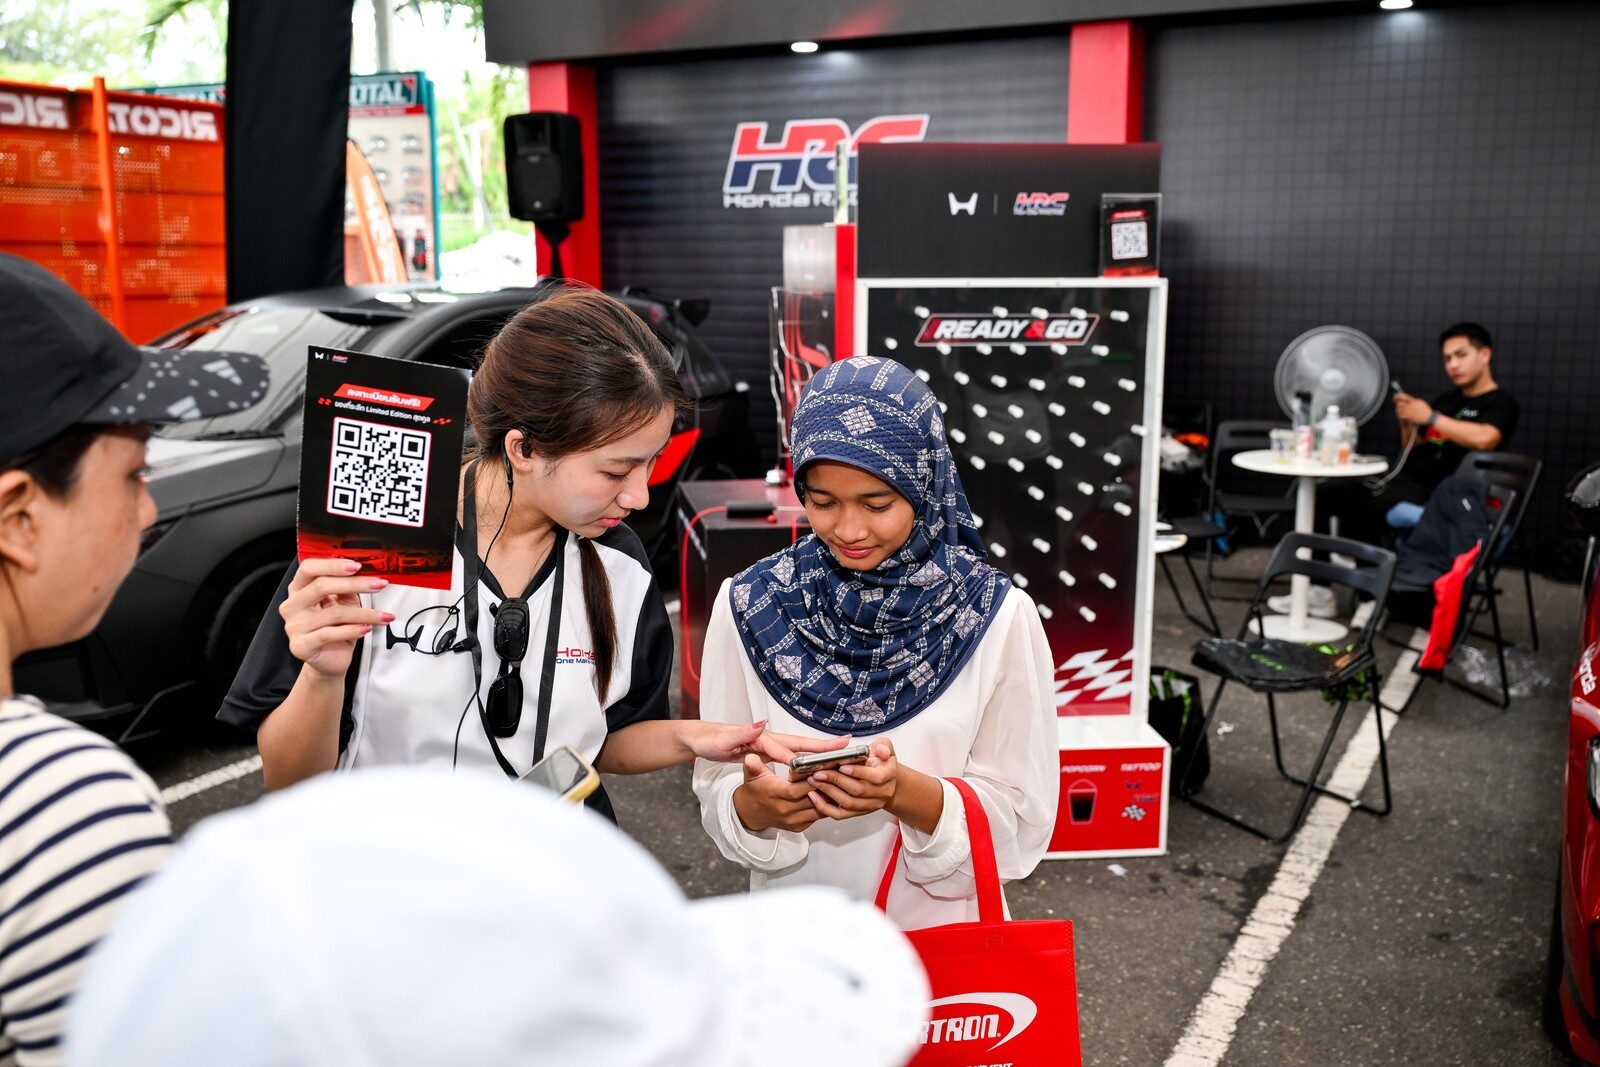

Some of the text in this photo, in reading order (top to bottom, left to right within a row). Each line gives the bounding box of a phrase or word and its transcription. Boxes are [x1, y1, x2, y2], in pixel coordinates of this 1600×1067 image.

[723, 192, 810, 208] Honda
[366, 405, 390, 416] Limited
[390, 409, 412, 420] Edition
[1120, 762, 1161, 772] TATTOO
